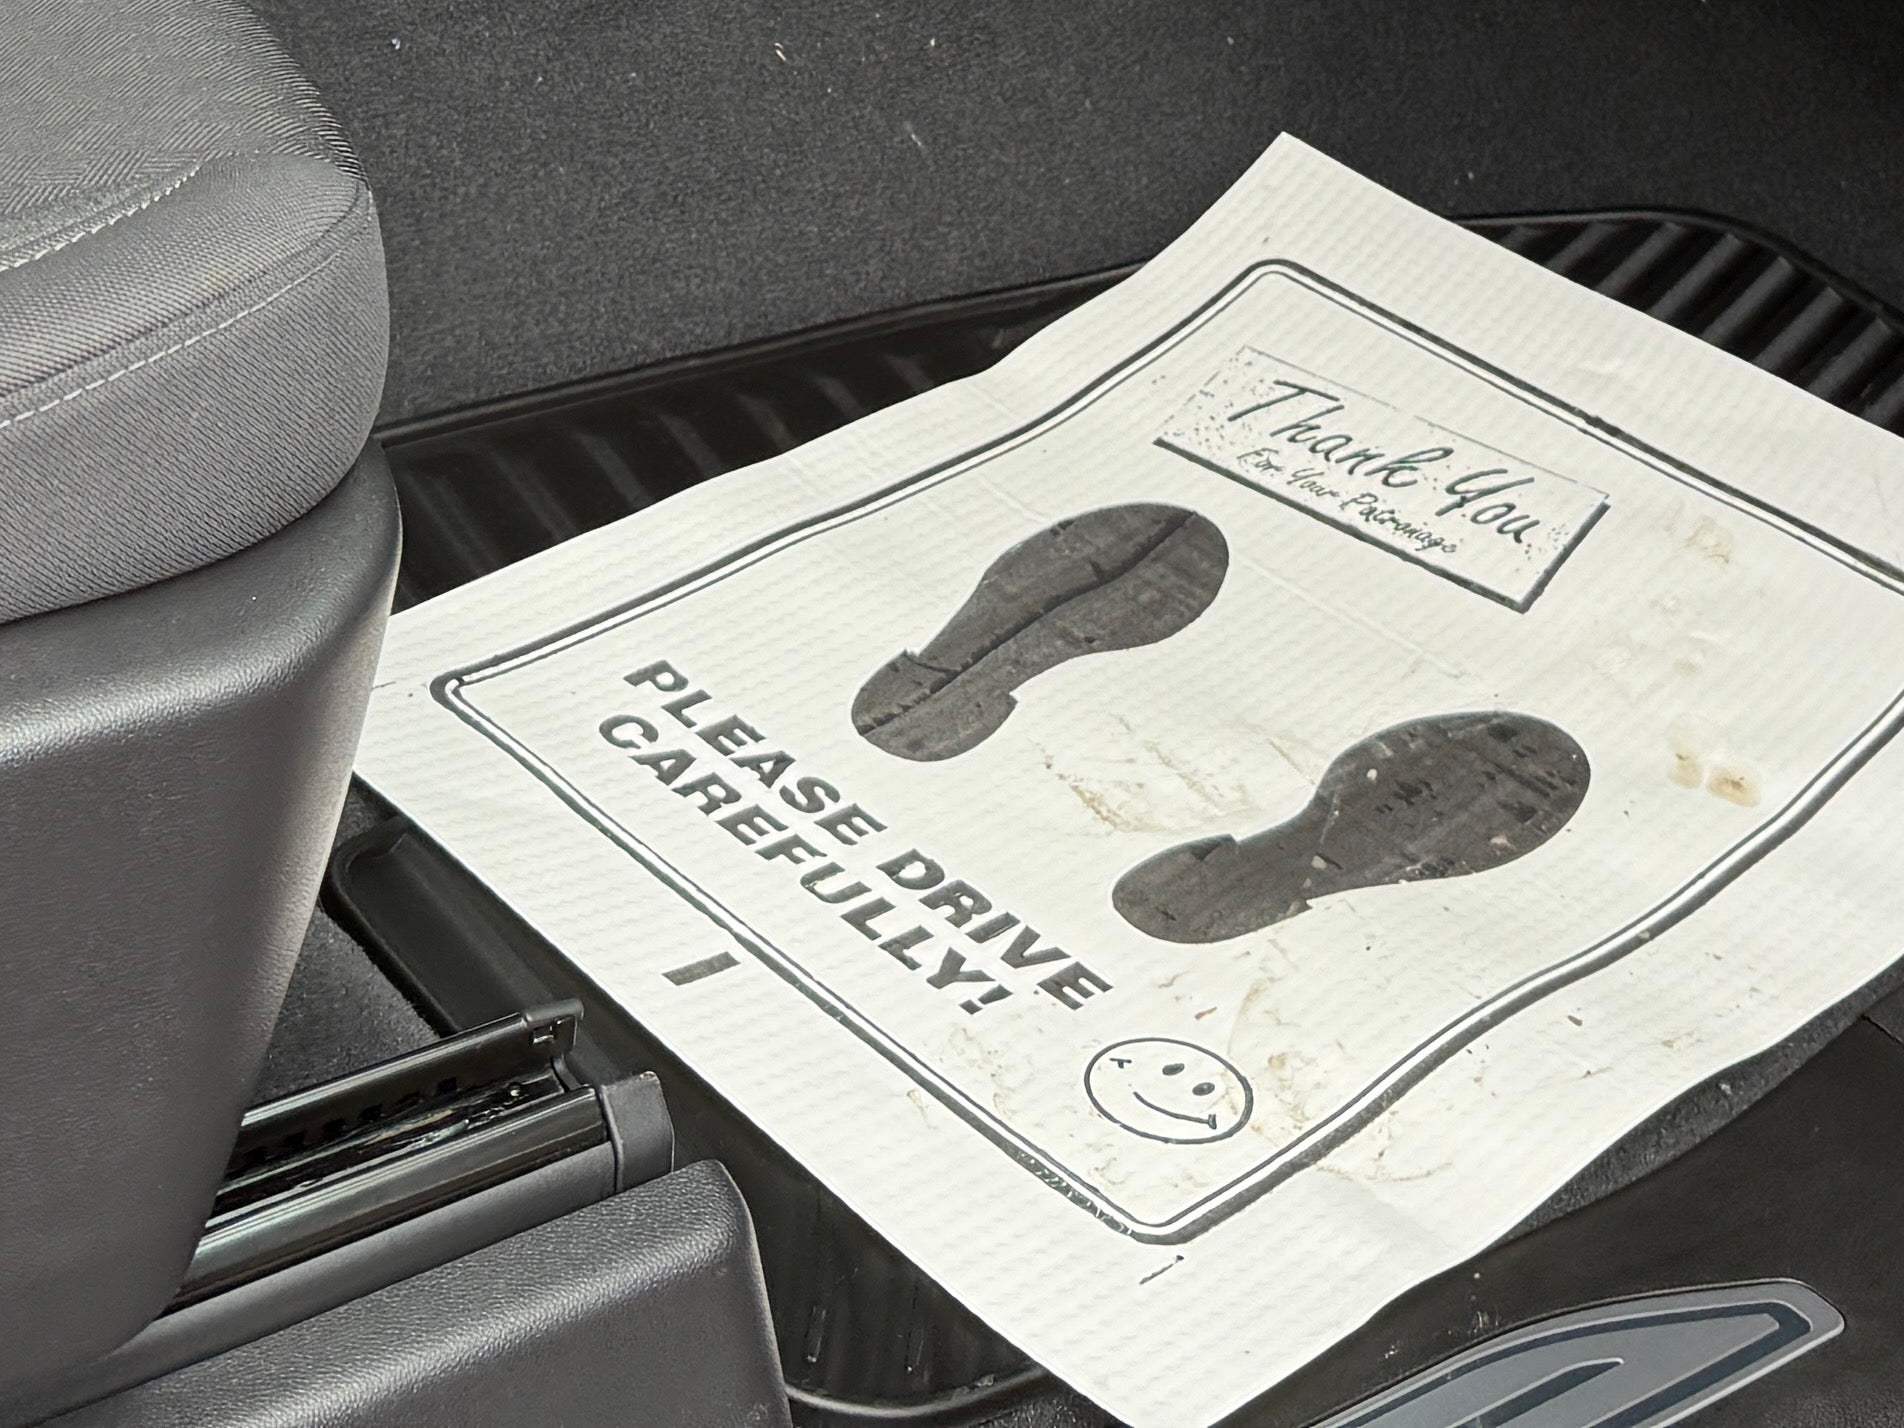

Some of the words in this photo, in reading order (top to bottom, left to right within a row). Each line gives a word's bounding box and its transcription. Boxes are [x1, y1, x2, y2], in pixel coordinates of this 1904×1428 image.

[1226, 379, 1454, 490] Thank
[1435, 467, 1541, 546] You
[1236, 446, 1279, 474] For
[1287, 466, 1339, 501] Your
[1344, 490, 1458, 556] Patronage
[598, 713, 1015, 1016] CAREFULLY!
[622, 659, 889, 846] PLEASE
[875, 847, 1115, 1013] DRIVE
